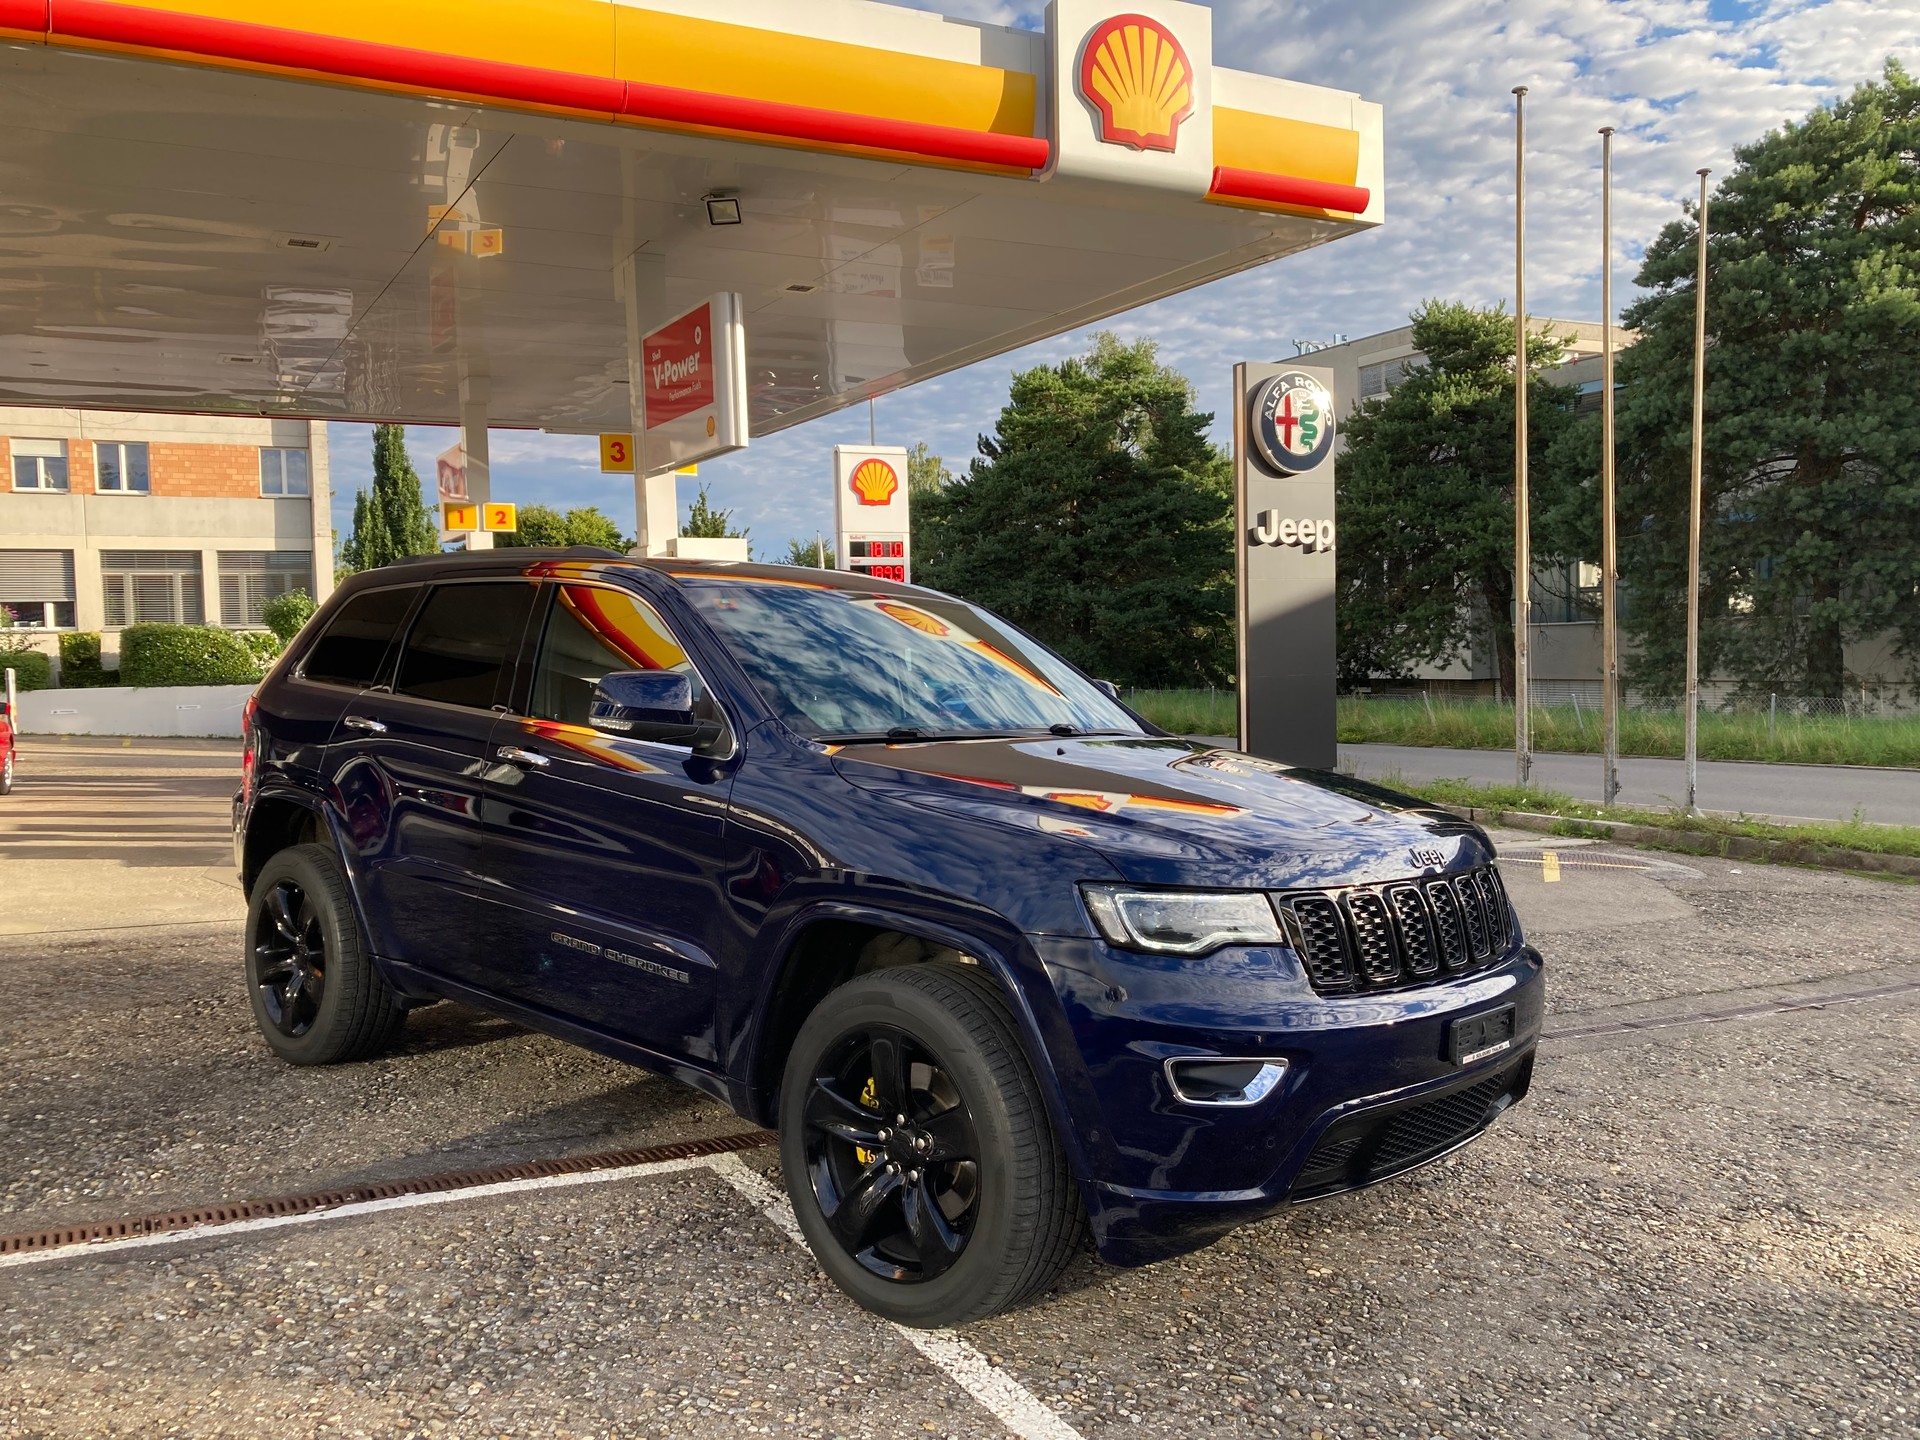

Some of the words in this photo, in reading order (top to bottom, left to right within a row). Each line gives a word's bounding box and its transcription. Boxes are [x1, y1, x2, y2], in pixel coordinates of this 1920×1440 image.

[651, 348, 661, 362] Shell
[652, 351, 700, 390] V-Power
[1264, 380, 1290, 421] ALFA
[609, 441, 626, 463] 3
[457, 509, 464, 524] 1
[495, 510, 507, 525] 2
[1256, 508, 1335, 552] Jeep
[1409, 848, 1449, 869] Jeep
[551, 931, 600, 956] GRAND
[604, 948, 689, 984] CHEROKEE
